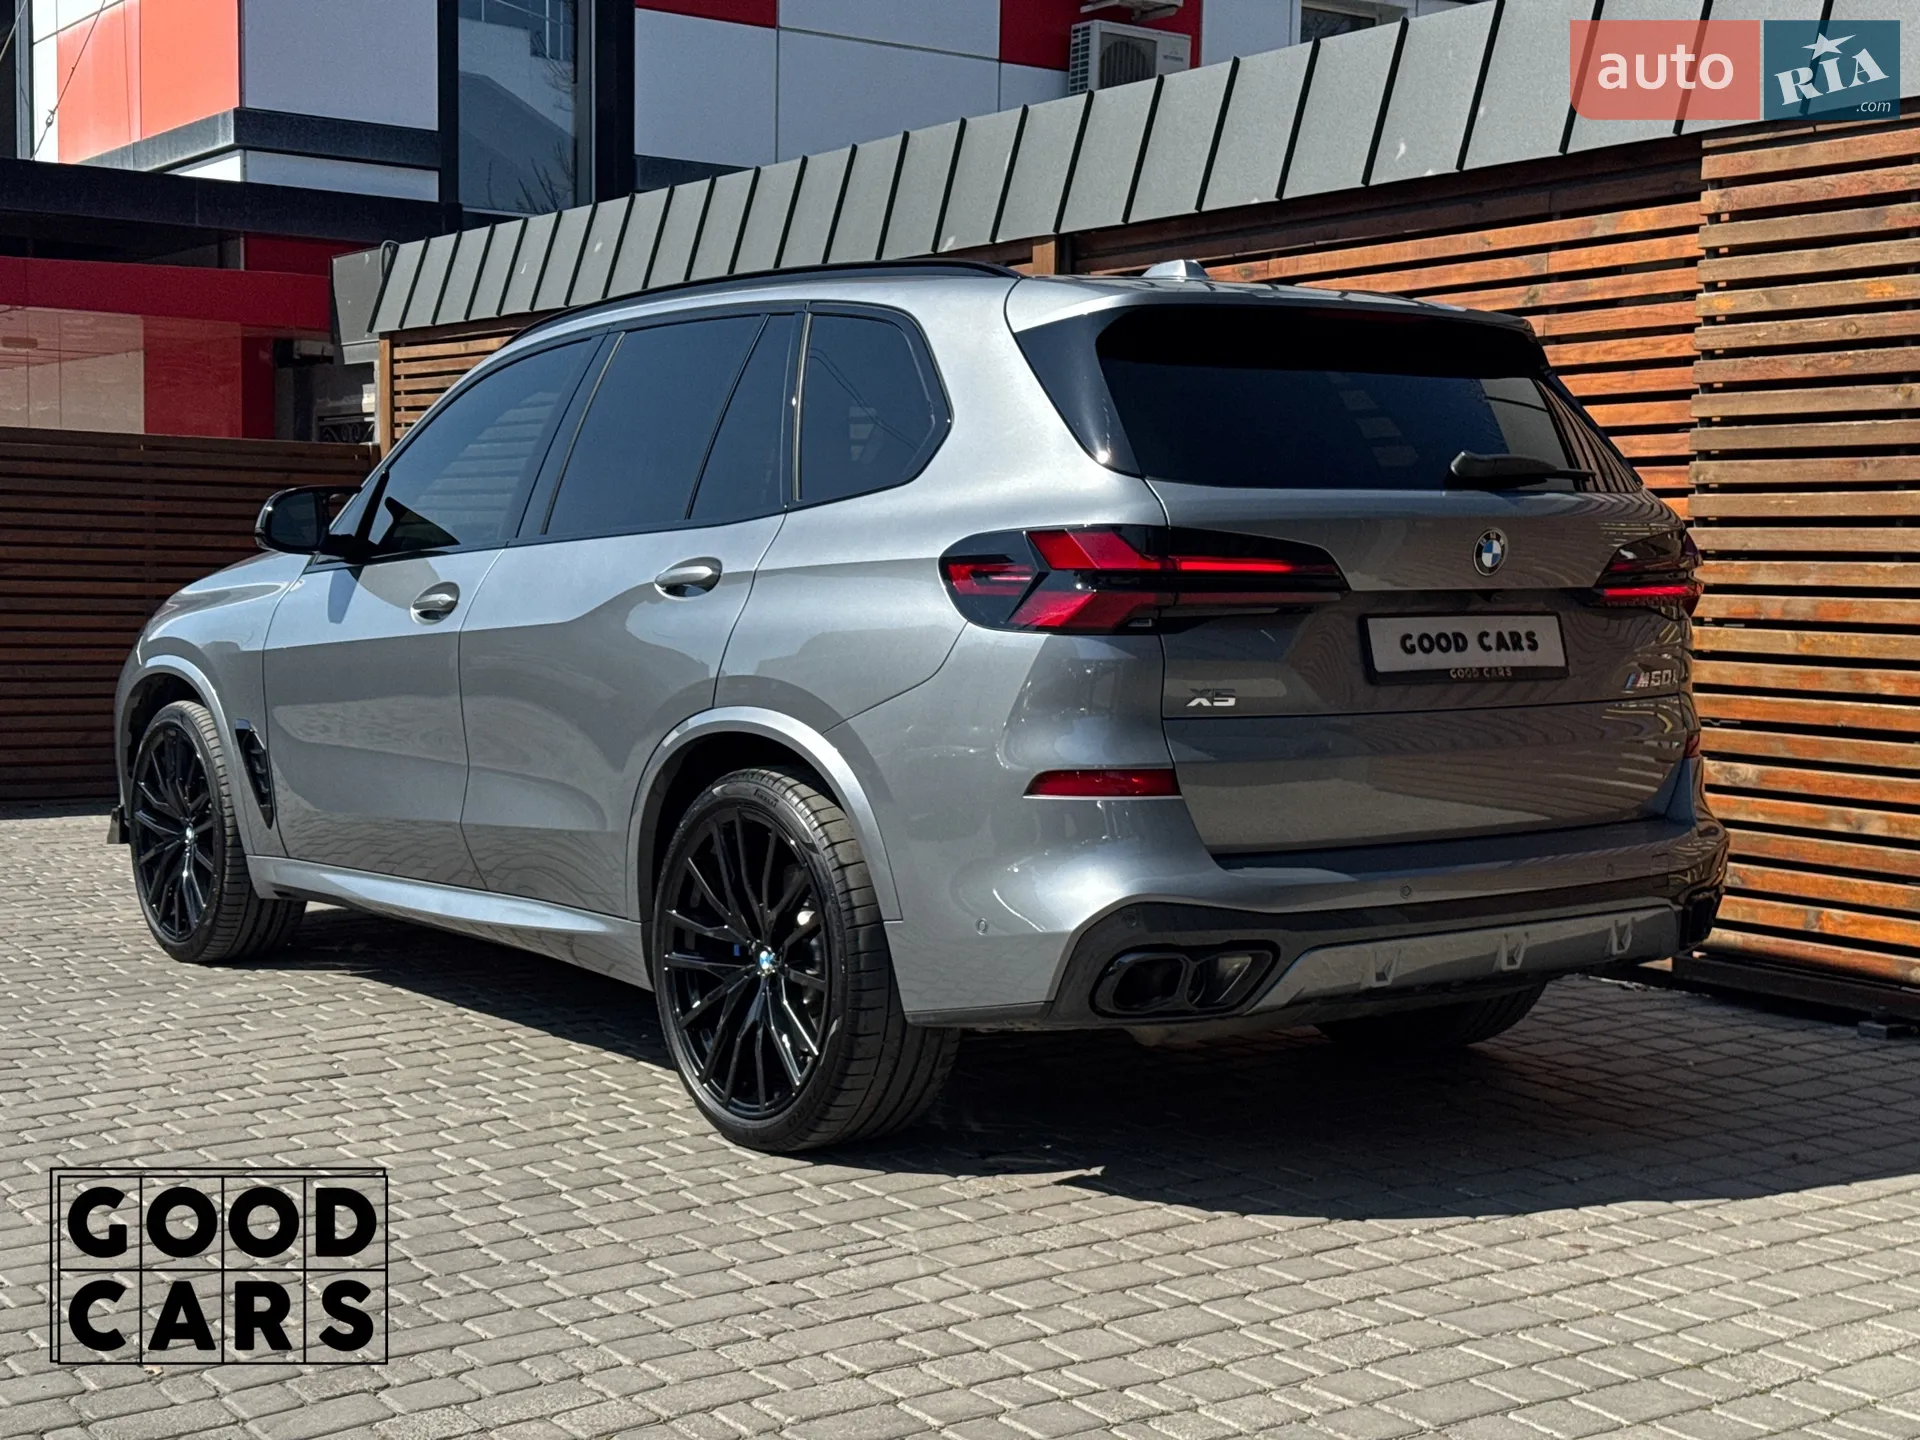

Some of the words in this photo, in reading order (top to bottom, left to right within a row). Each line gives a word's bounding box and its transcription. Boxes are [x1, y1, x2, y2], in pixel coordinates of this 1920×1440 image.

[1400, 632, 1468, 655] GOOD
[1477, 630, 1539, 652] CARS
[1450, 667, 1480, 679] GOOD
[1483, 666, 1513, 678] CARS
[1186, 688, 1236, 706] X5
